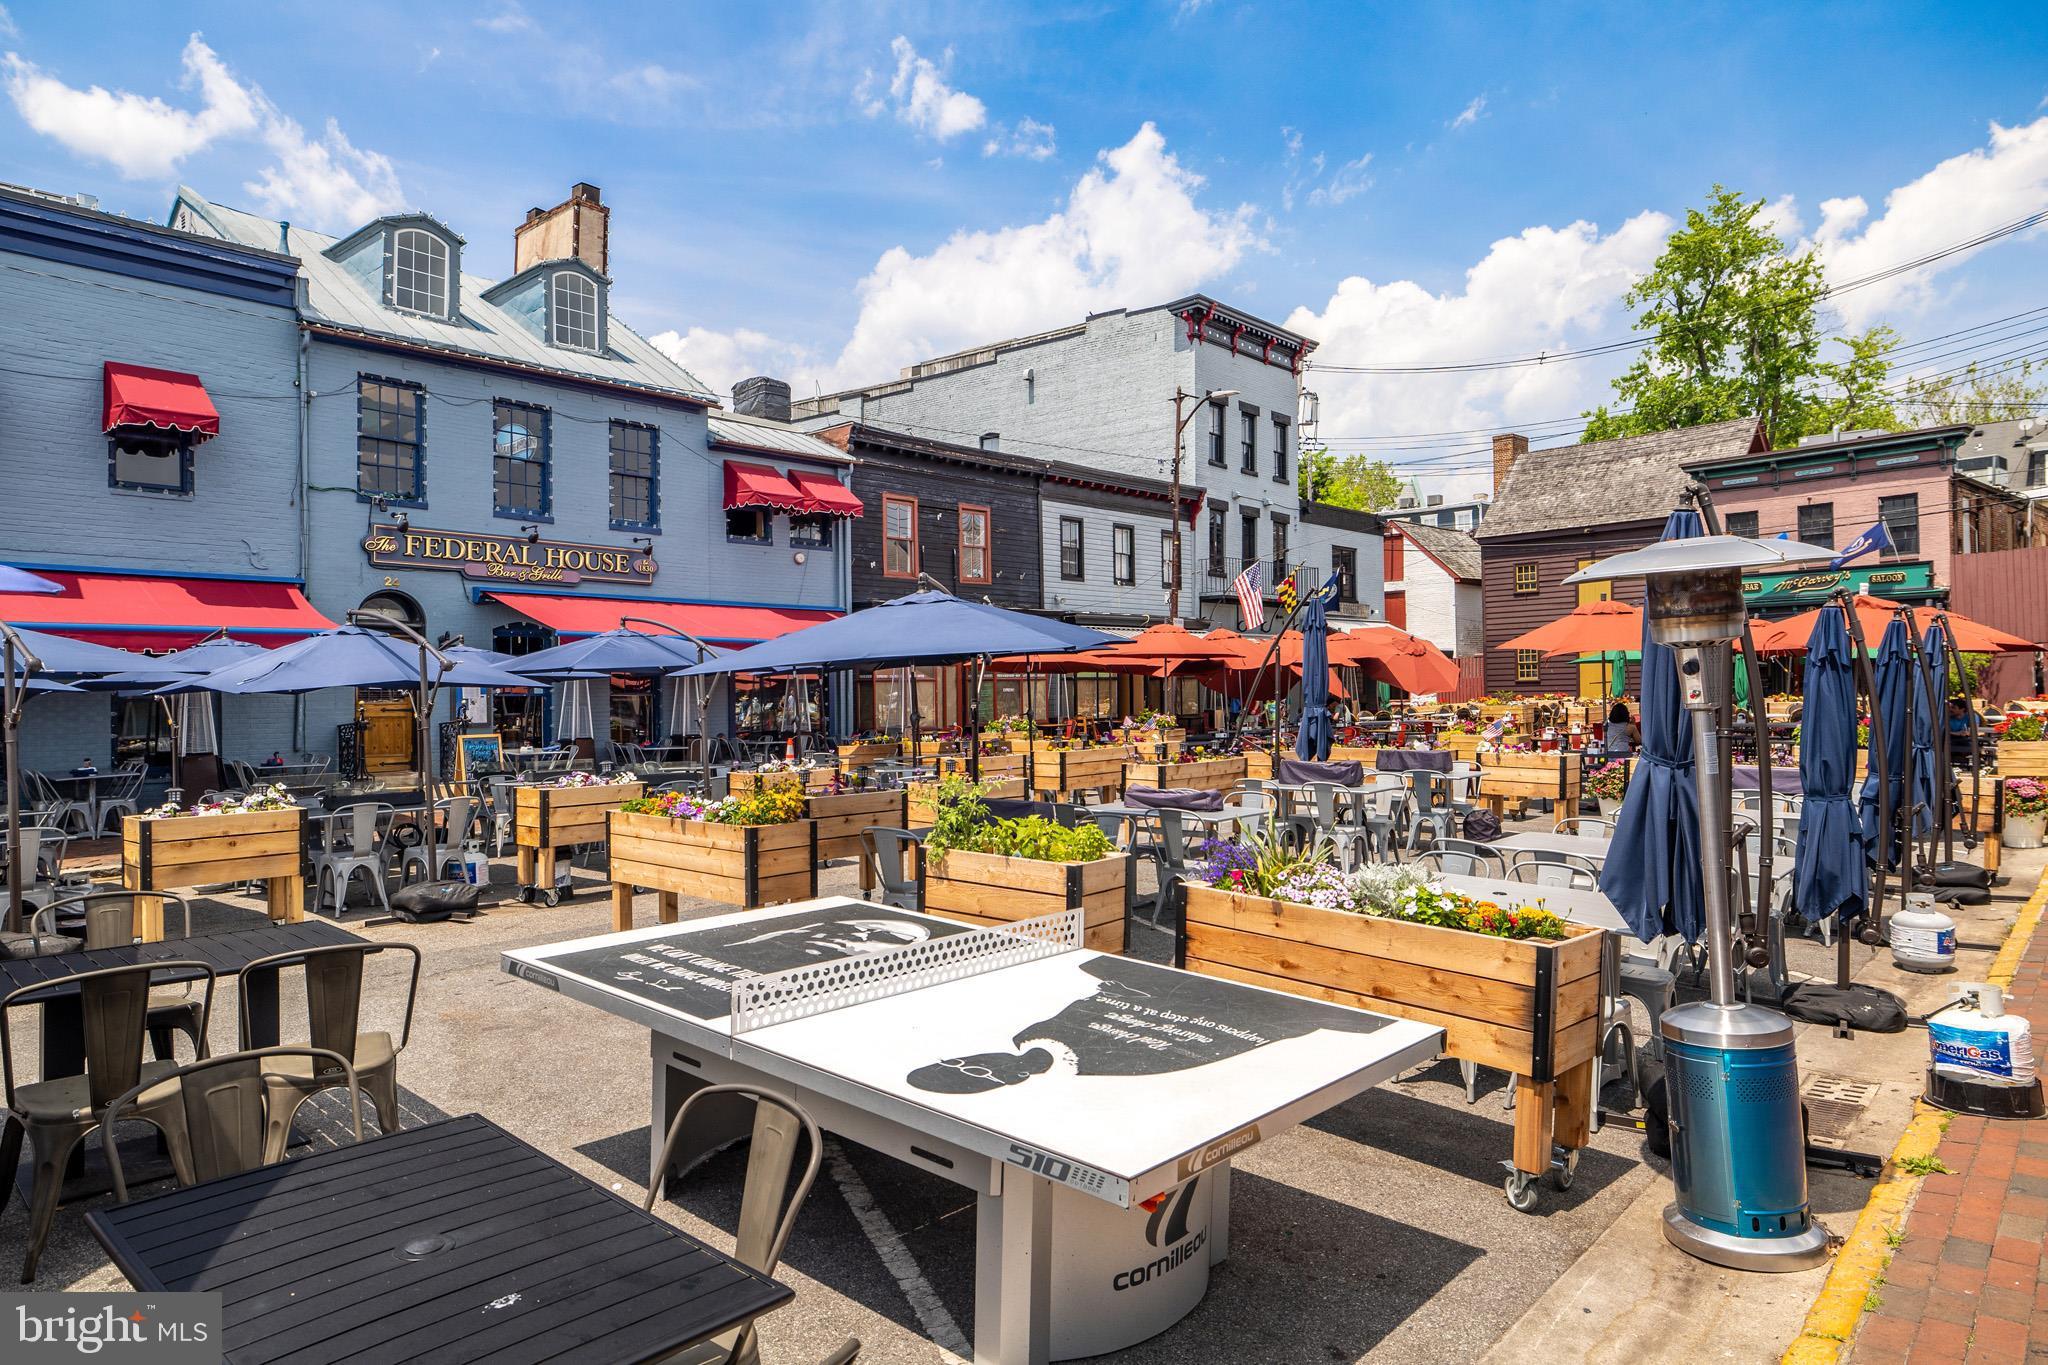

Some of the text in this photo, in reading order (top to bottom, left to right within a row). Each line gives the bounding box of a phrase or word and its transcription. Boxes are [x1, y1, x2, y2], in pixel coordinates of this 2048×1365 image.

[365, 534, 630, 574] The FEDERAL HOUSE
[486, 562, 563, 582] Bar & Grille
[638, 564, 654, 574] 1830
[1871, 573, 1904, 583] SALOON
[1744, 583, 1760, 591] BAR
[1773, 570, 1852, 593] McGarvey's
[1133, 1004, 1142, 1012] a
[1143, 1007, 1159, 1017] at
[1160, 1010, 1190, 1023] step
[1215, 1024, 1272, 1047] happens
[1205, 1130, 1254, 1163] cornilleau
[1006, 1144, 1072, 1182] 510
[1113, 1226, 1208, 1292] cornilleau
